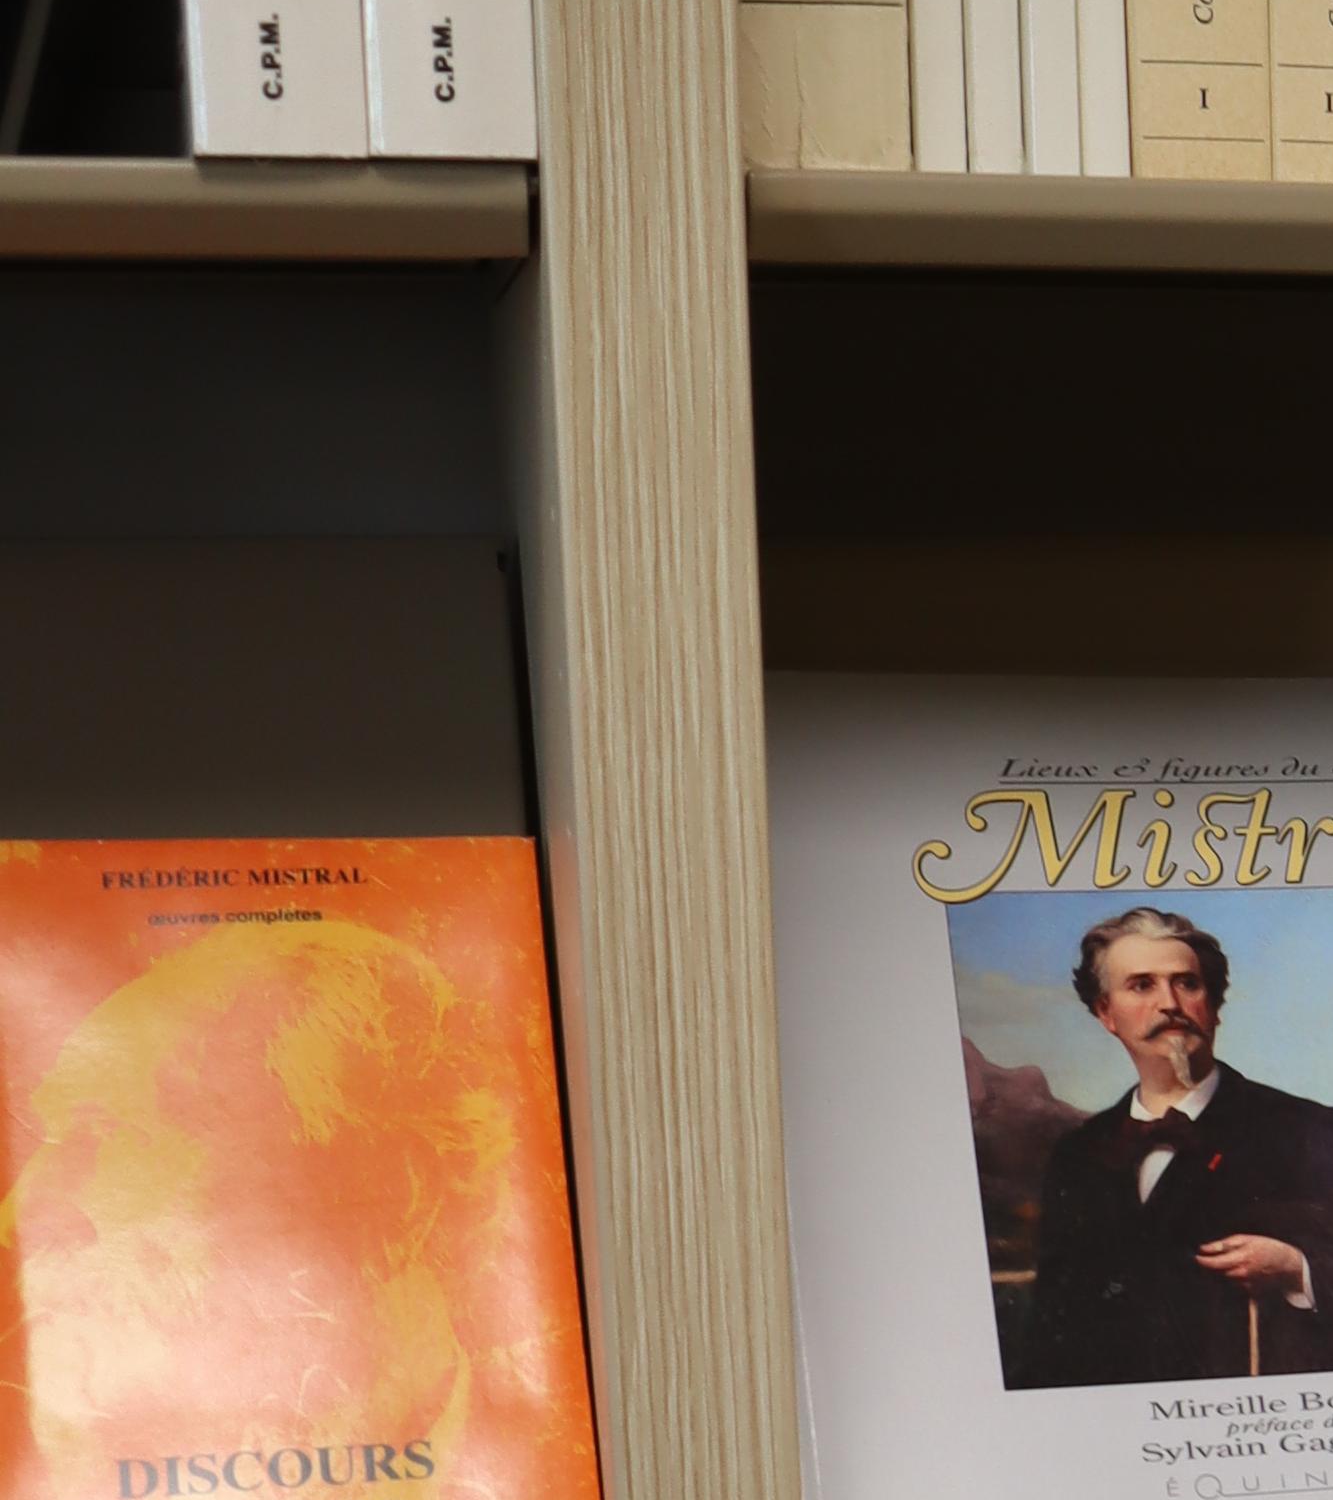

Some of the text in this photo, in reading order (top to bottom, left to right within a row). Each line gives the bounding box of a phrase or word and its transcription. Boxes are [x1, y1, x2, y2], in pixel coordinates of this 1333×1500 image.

[261, 12, 282, 102] C.P.M.
[1199, 88, 1209, 110] I
[1000, 757, 1100, 780] Lieux
[1154, 758, 1270, 784] figures
[1281, 758, 1320, 779] du
[100, 865, 368, 891] FRÉDÉRIC MISTRAL
[1149, 1396, 1287, 1421] Mireille
[1225, 1419, 1314, 1438] préface
[1142, 1439, 1267, 1465] Sylvain
